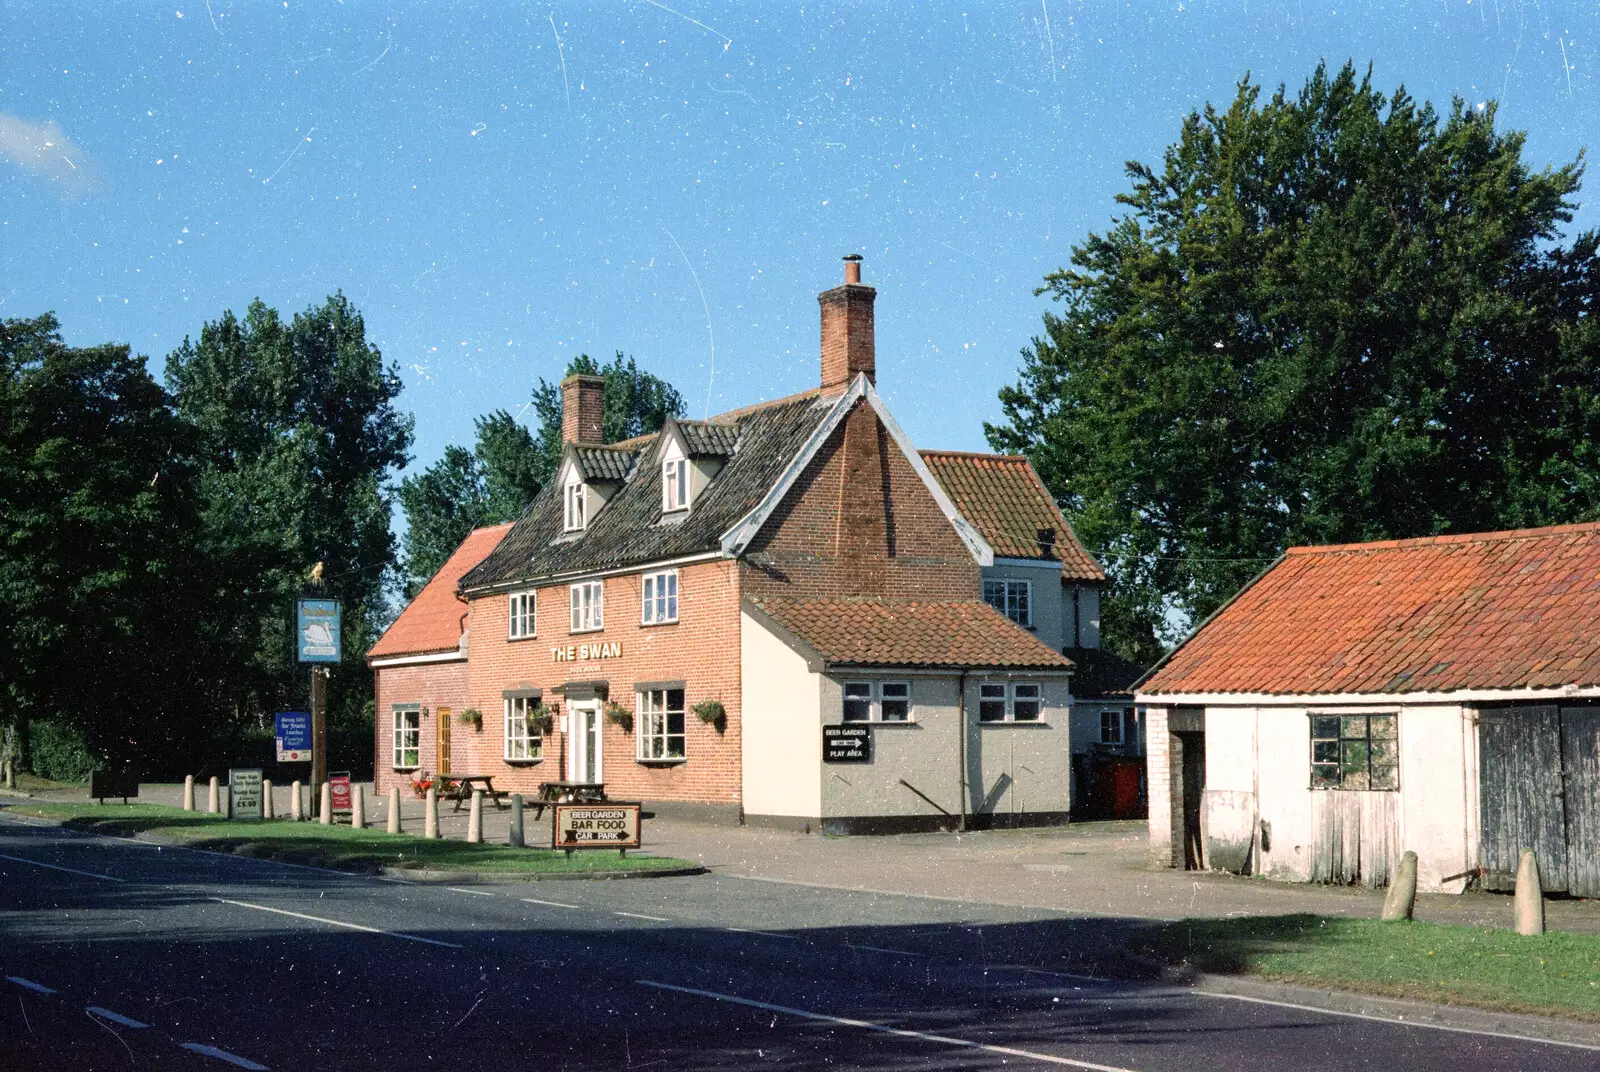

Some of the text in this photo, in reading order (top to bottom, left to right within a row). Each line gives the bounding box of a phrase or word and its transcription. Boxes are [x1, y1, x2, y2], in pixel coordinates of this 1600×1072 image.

[551, 642, 623, 662] THE SWAN
[572, 811, 624, 819] BEER GARDEN
[571, 820, 626, 830] BAR FOOD
[575, 832, 618, 840] CAR PARK
